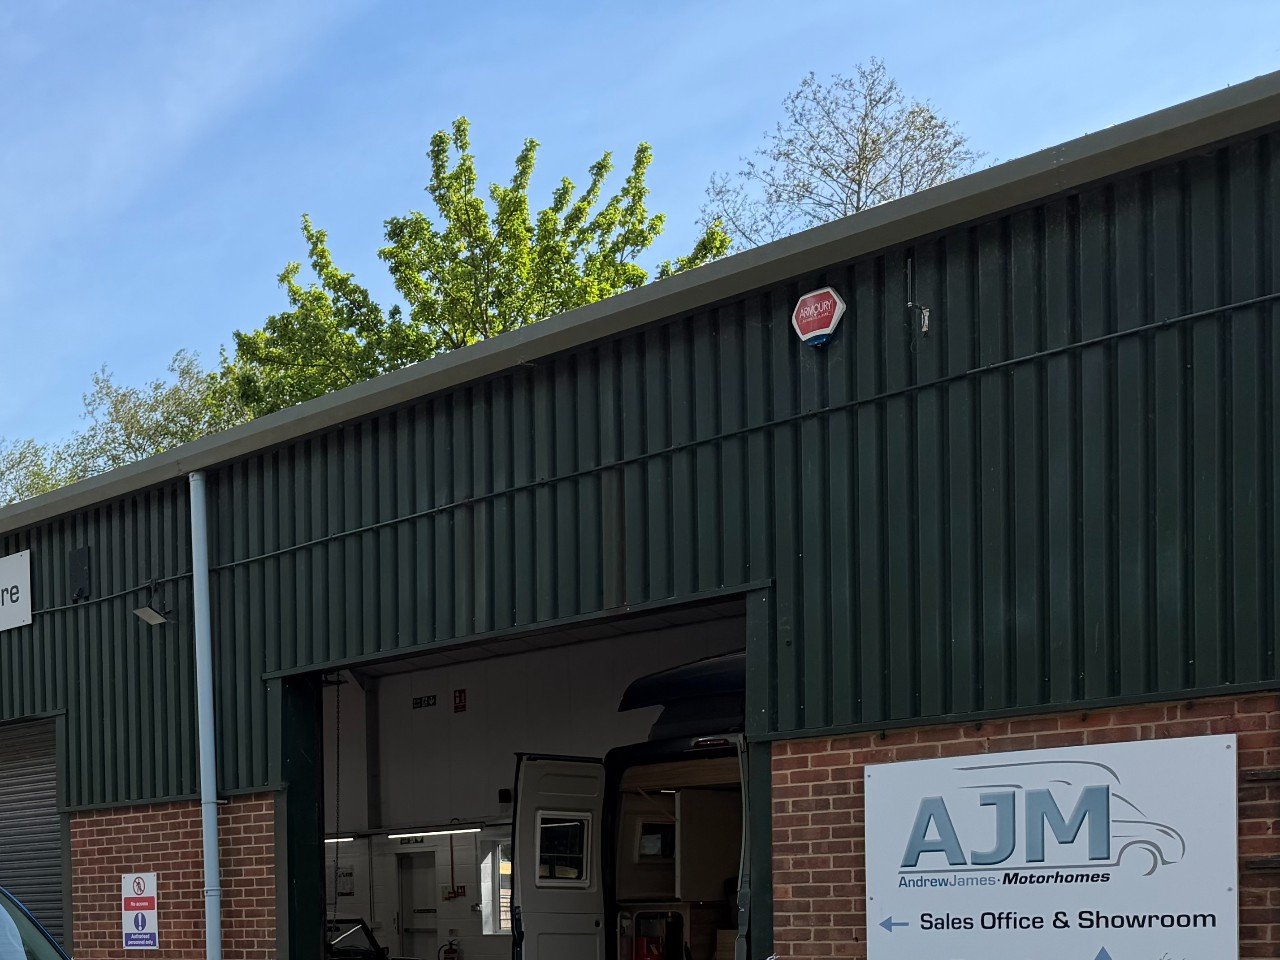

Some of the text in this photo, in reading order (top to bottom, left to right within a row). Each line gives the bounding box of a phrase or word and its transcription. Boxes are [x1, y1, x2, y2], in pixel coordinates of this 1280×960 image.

[799, 300, 832, 318] ARMOURY
[900, 784, 1111, 868] AJM
[1002, 871, 1111, 885] Motorhomes
[920, 910, 1217, 930] Sales Office & Showroom
